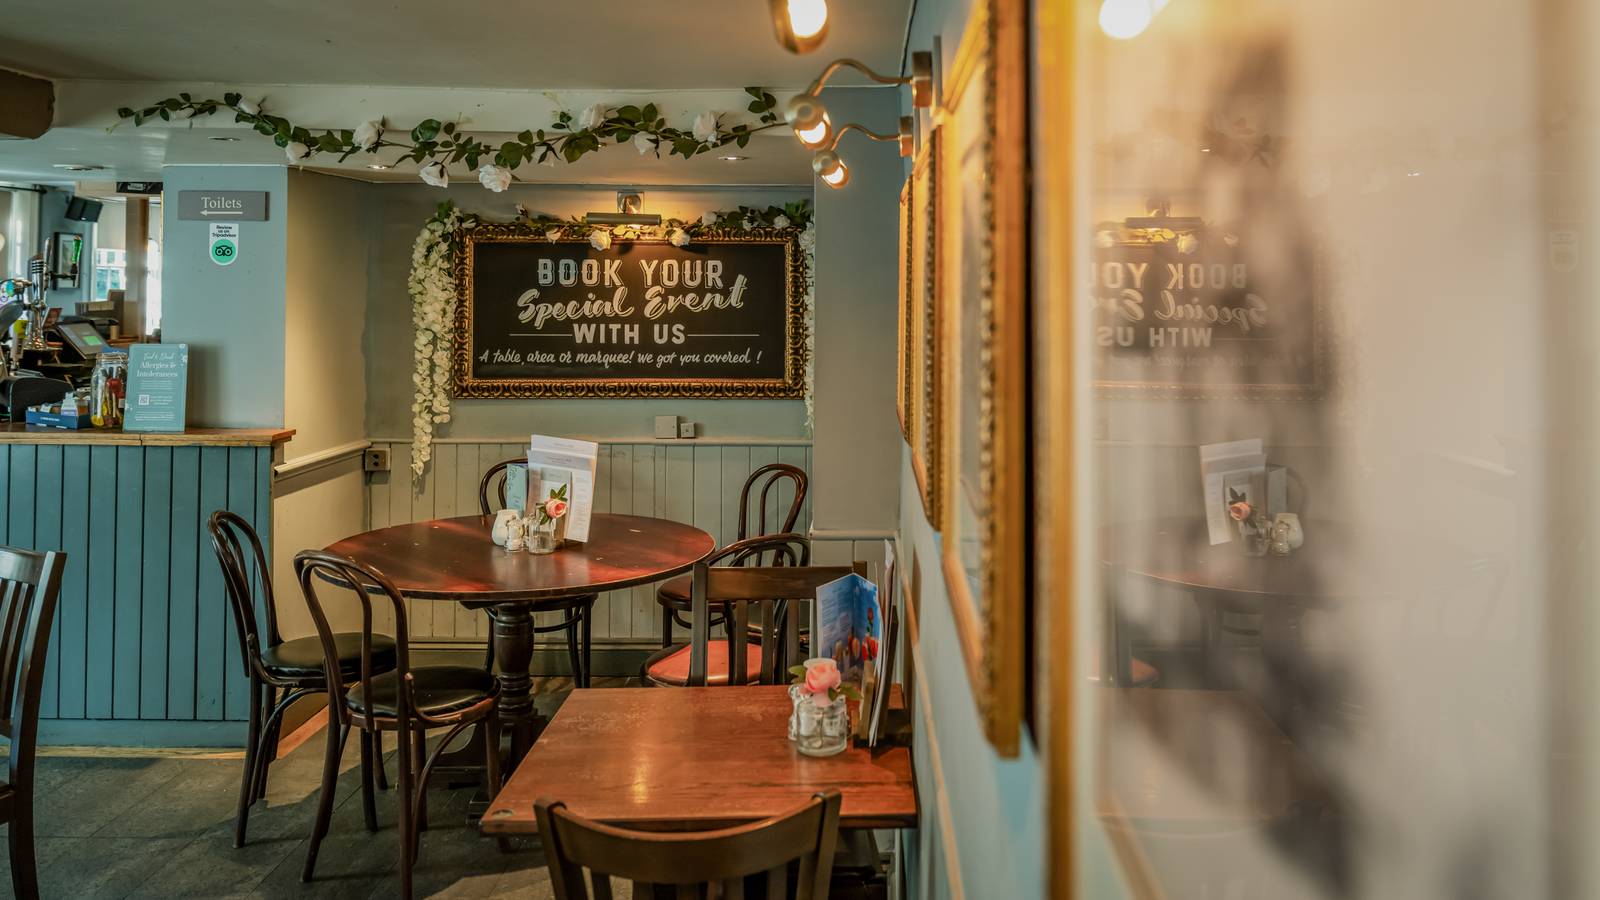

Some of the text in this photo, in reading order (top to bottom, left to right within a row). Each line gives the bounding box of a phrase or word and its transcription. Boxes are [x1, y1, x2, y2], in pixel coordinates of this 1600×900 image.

[201, 197, 242, 209] Toilets
[537, 259, 724, 289] BOOK YOUR
[517, 273, 748, 330] Special Event
[573, 324, 686, 345] WITH US
[479, 349, 490, 363] A
[526, 350, 556, 363] area
[559, 351, 573, 363] or
[575, 350, 635, 369] marquee!
[655, 351, 677, 369] got
[679, 353, 701, 367] you
[703, 347, 751, 363] covered
[136, 370, 178, 378] Intolerances
